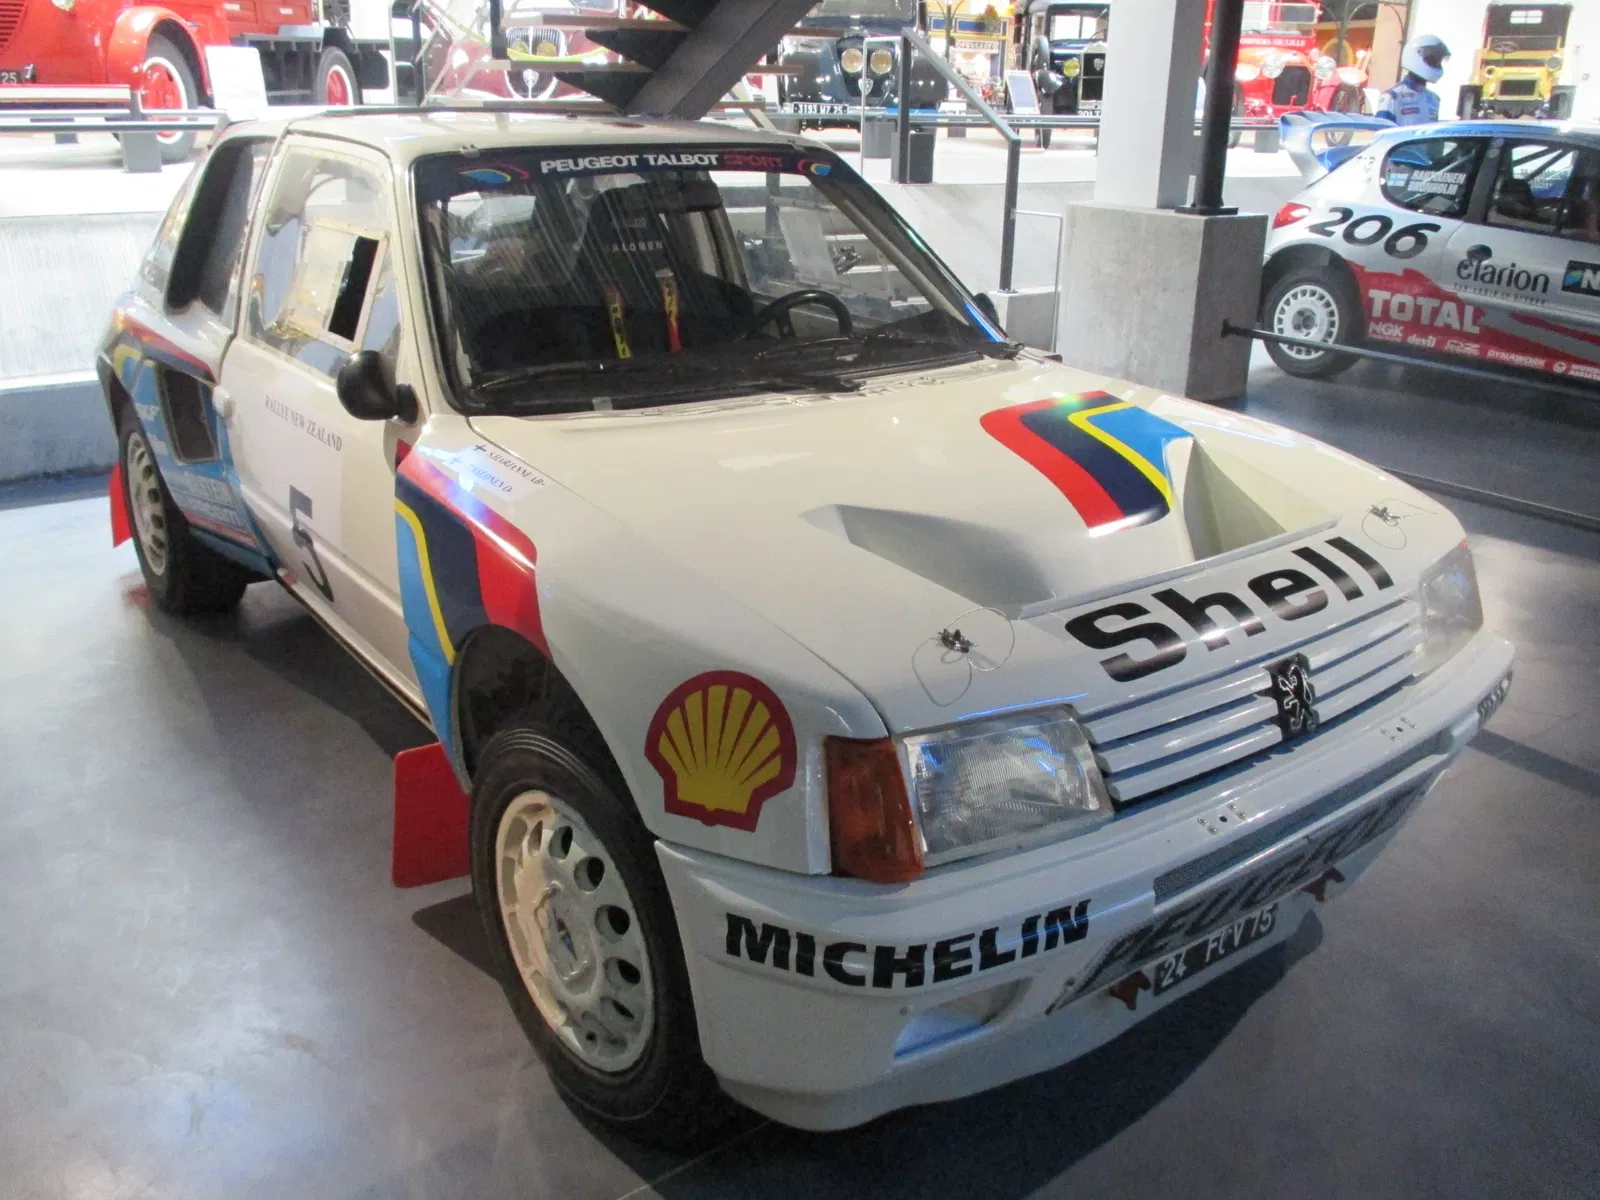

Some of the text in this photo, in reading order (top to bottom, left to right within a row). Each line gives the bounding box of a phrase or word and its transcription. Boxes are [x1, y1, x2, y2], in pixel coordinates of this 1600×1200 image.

[540, 153, 784, 174] PEUGEOT TALBOT SPORT
[1305, 206, 1442, 260] 206
[1456, 258, 1550, 294] clarion
[1368, 288, 1480, 334] TOTAL
[1369, 321, 1405, 337] NGK
[264, 394, 343, 452] RALLYE NEW ZEALAND
[289, 484, 335, 603] 5
[1064, 535, 1395, 683] Shell
[725, 899, 1092, 989] MICHELIN
[1161, 948, 1188, 988] 24
[1247, 905, 1273, 938] 75
